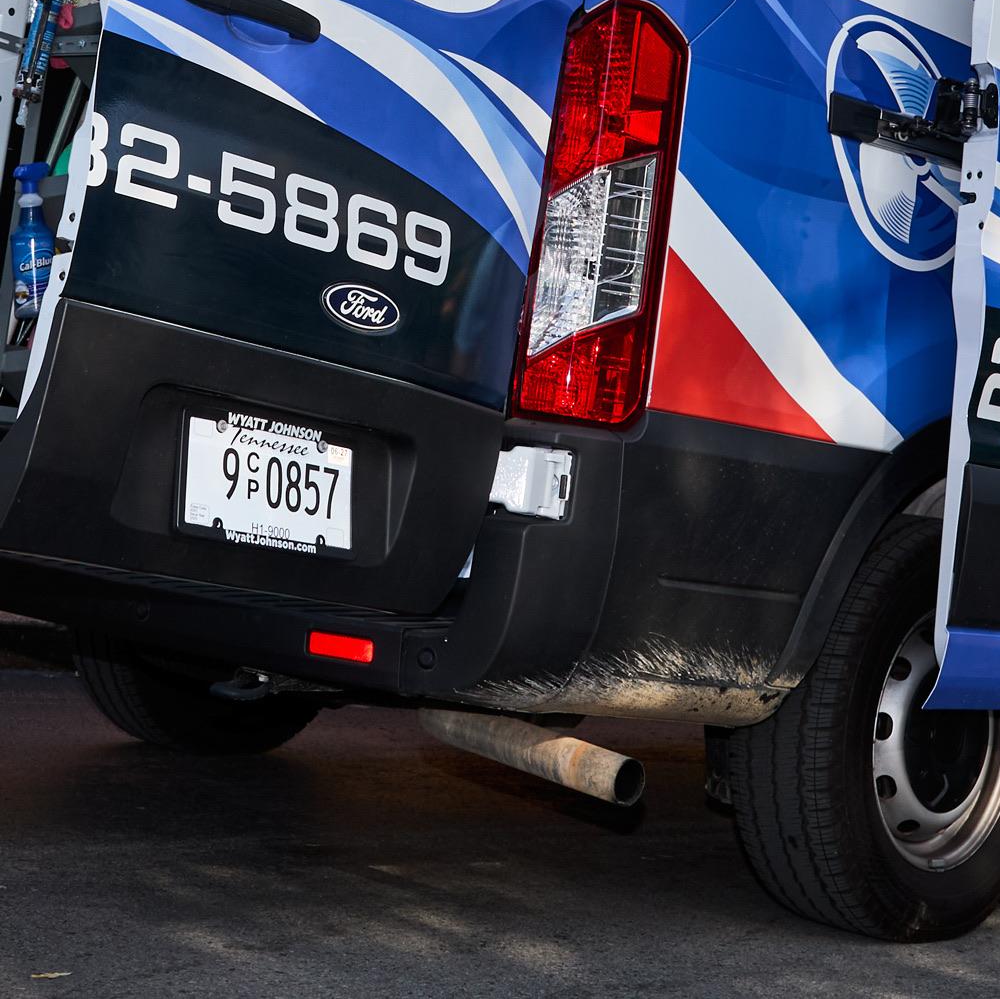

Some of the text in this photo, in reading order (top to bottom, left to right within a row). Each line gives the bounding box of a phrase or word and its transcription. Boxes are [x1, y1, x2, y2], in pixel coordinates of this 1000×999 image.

[340, 289, 389, 325] Ford
[228, 411, 322, 442] WYATT JOHNSON
[230, 427, 310, 456] Tennessee
[266, 456, 340, 520] 0857
[225, 529, 317, 554] WyattJohnson.com
